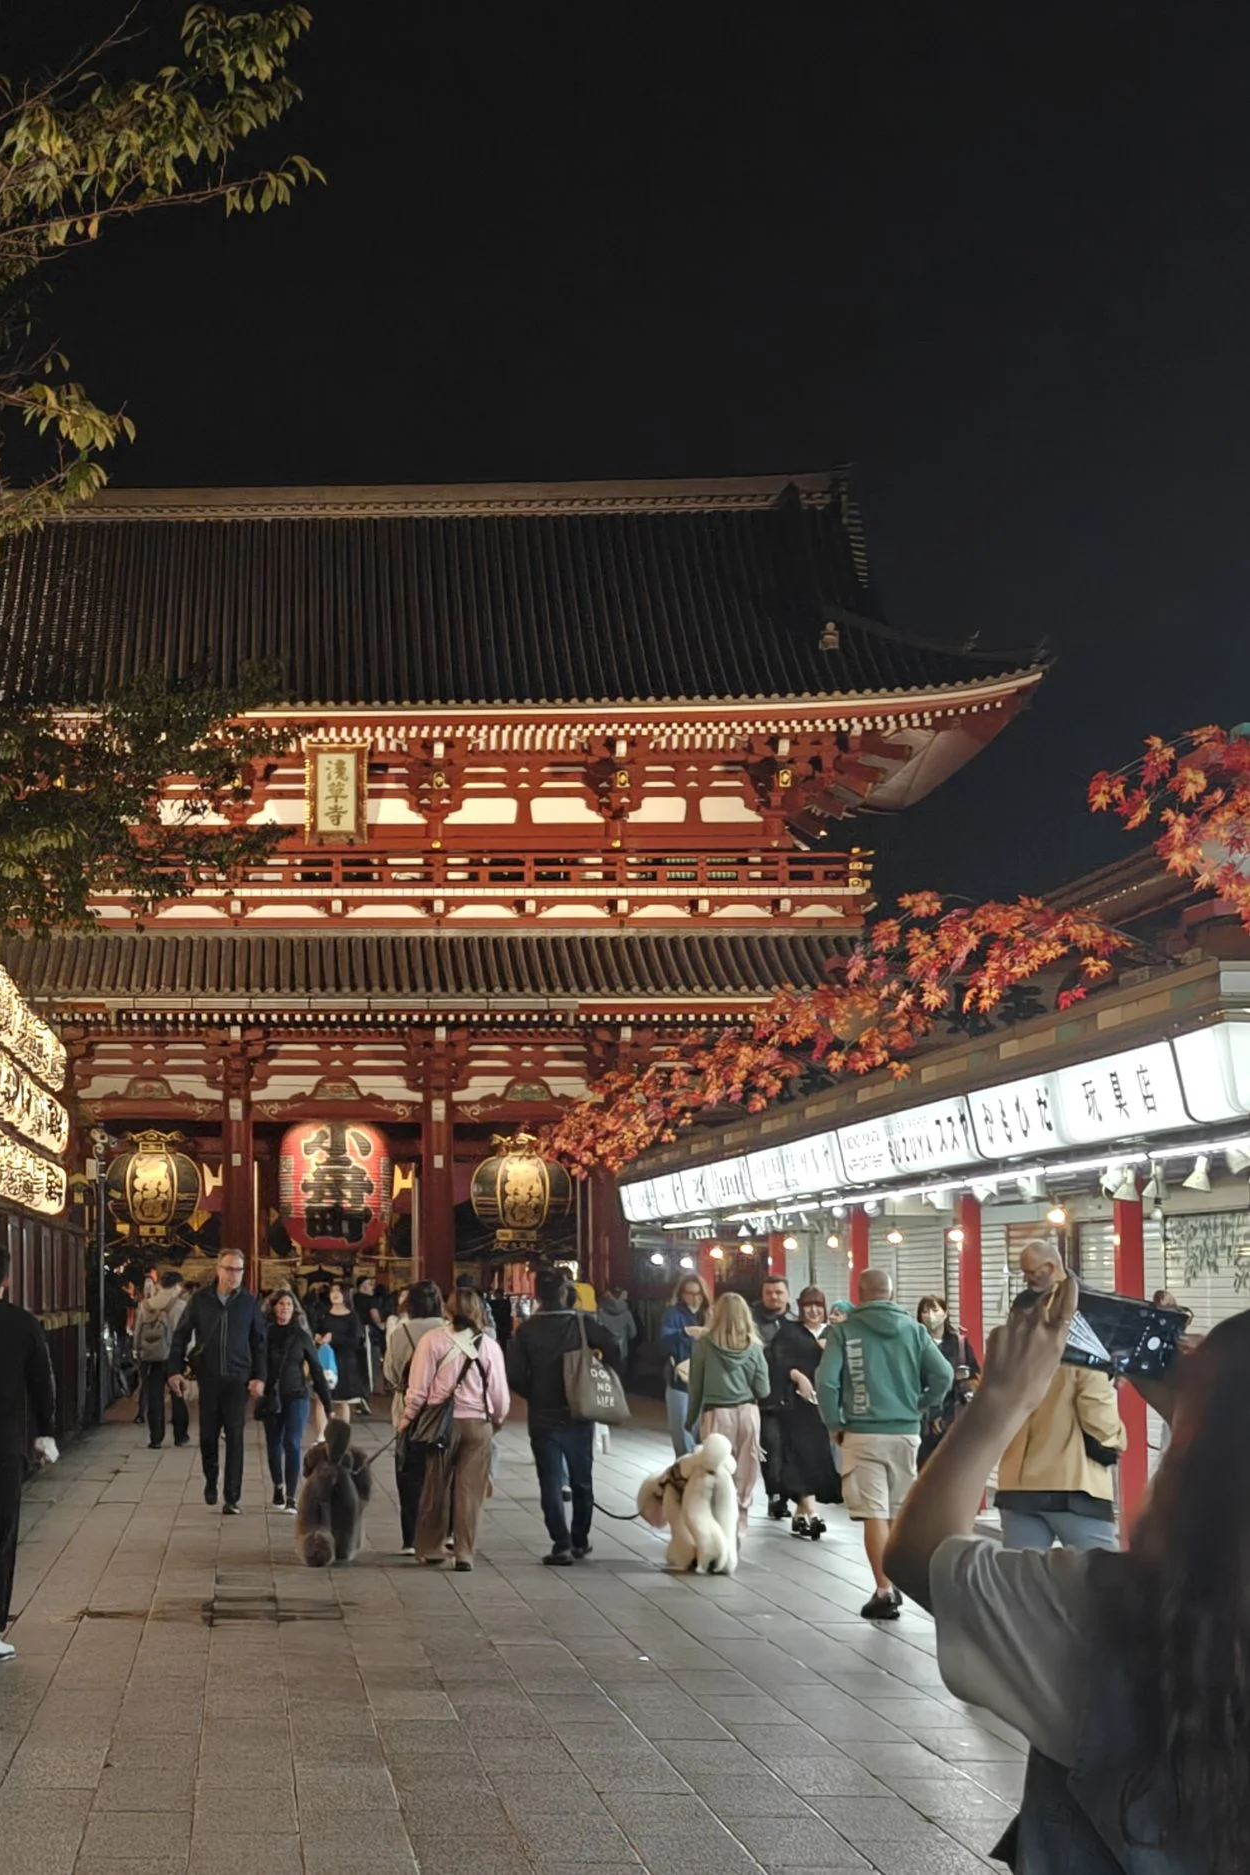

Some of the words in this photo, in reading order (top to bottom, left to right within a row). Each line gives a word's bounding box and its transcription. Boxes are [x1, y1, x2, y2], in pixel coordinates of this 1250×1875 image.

[1081, 1063, 1158, 1122] 玩具店
[887, 1133, 935, 1166] SUZUYA
[597, 1382, 612, 1393] NO
